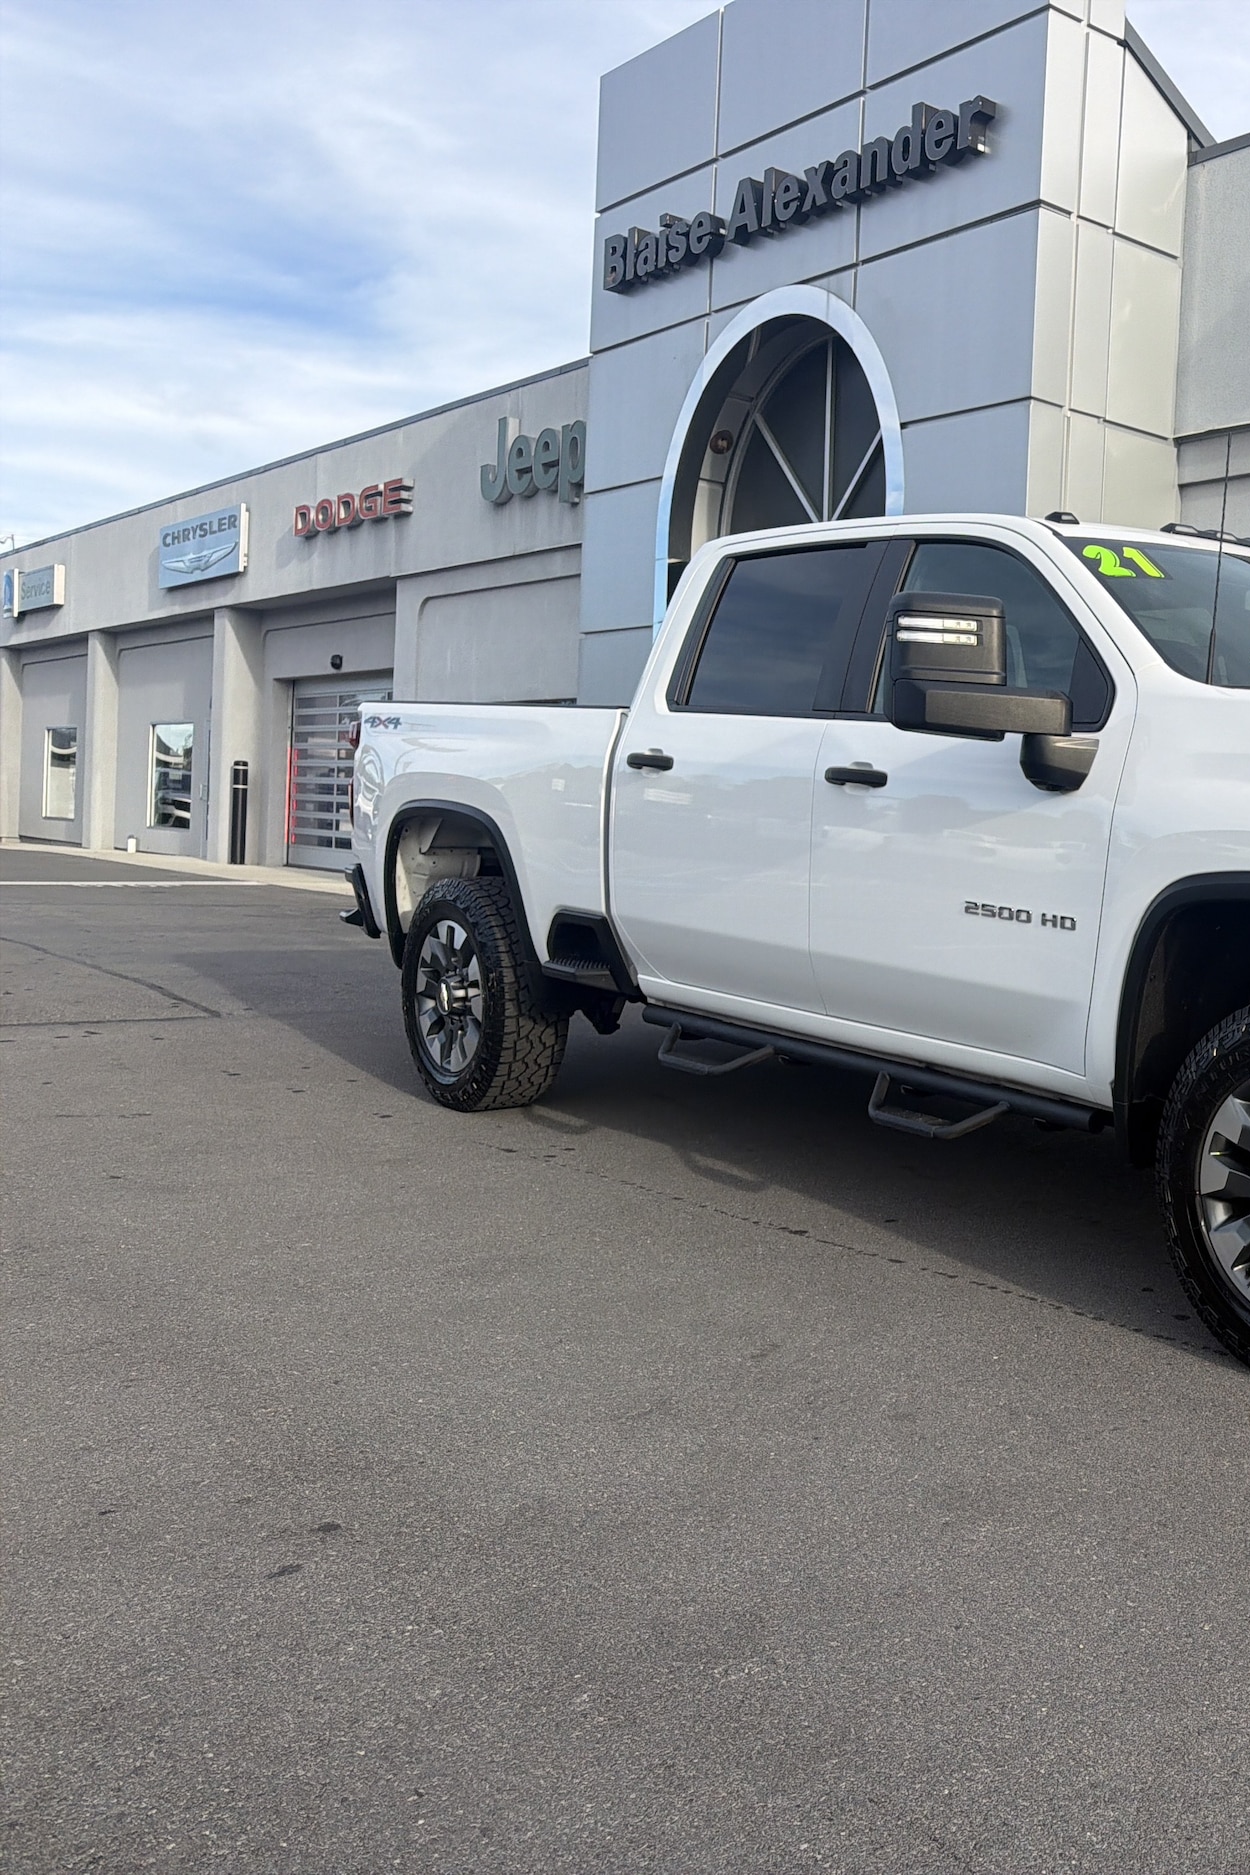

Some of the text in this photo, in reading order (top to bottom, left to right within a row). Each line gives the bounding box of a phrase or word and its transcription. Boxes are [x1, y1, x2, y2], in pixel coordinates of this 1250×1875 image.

[603, 95, 996, 292] Blaise Alexander
[480, 416, 586, 504] Jeep
[162, 514, 238, 548] CHRYSLER
[293, 478, 414, 538] DODGE
[1082, 544, 1165, 578] 21
[964, 900, 1078, 931] 2500 HD
